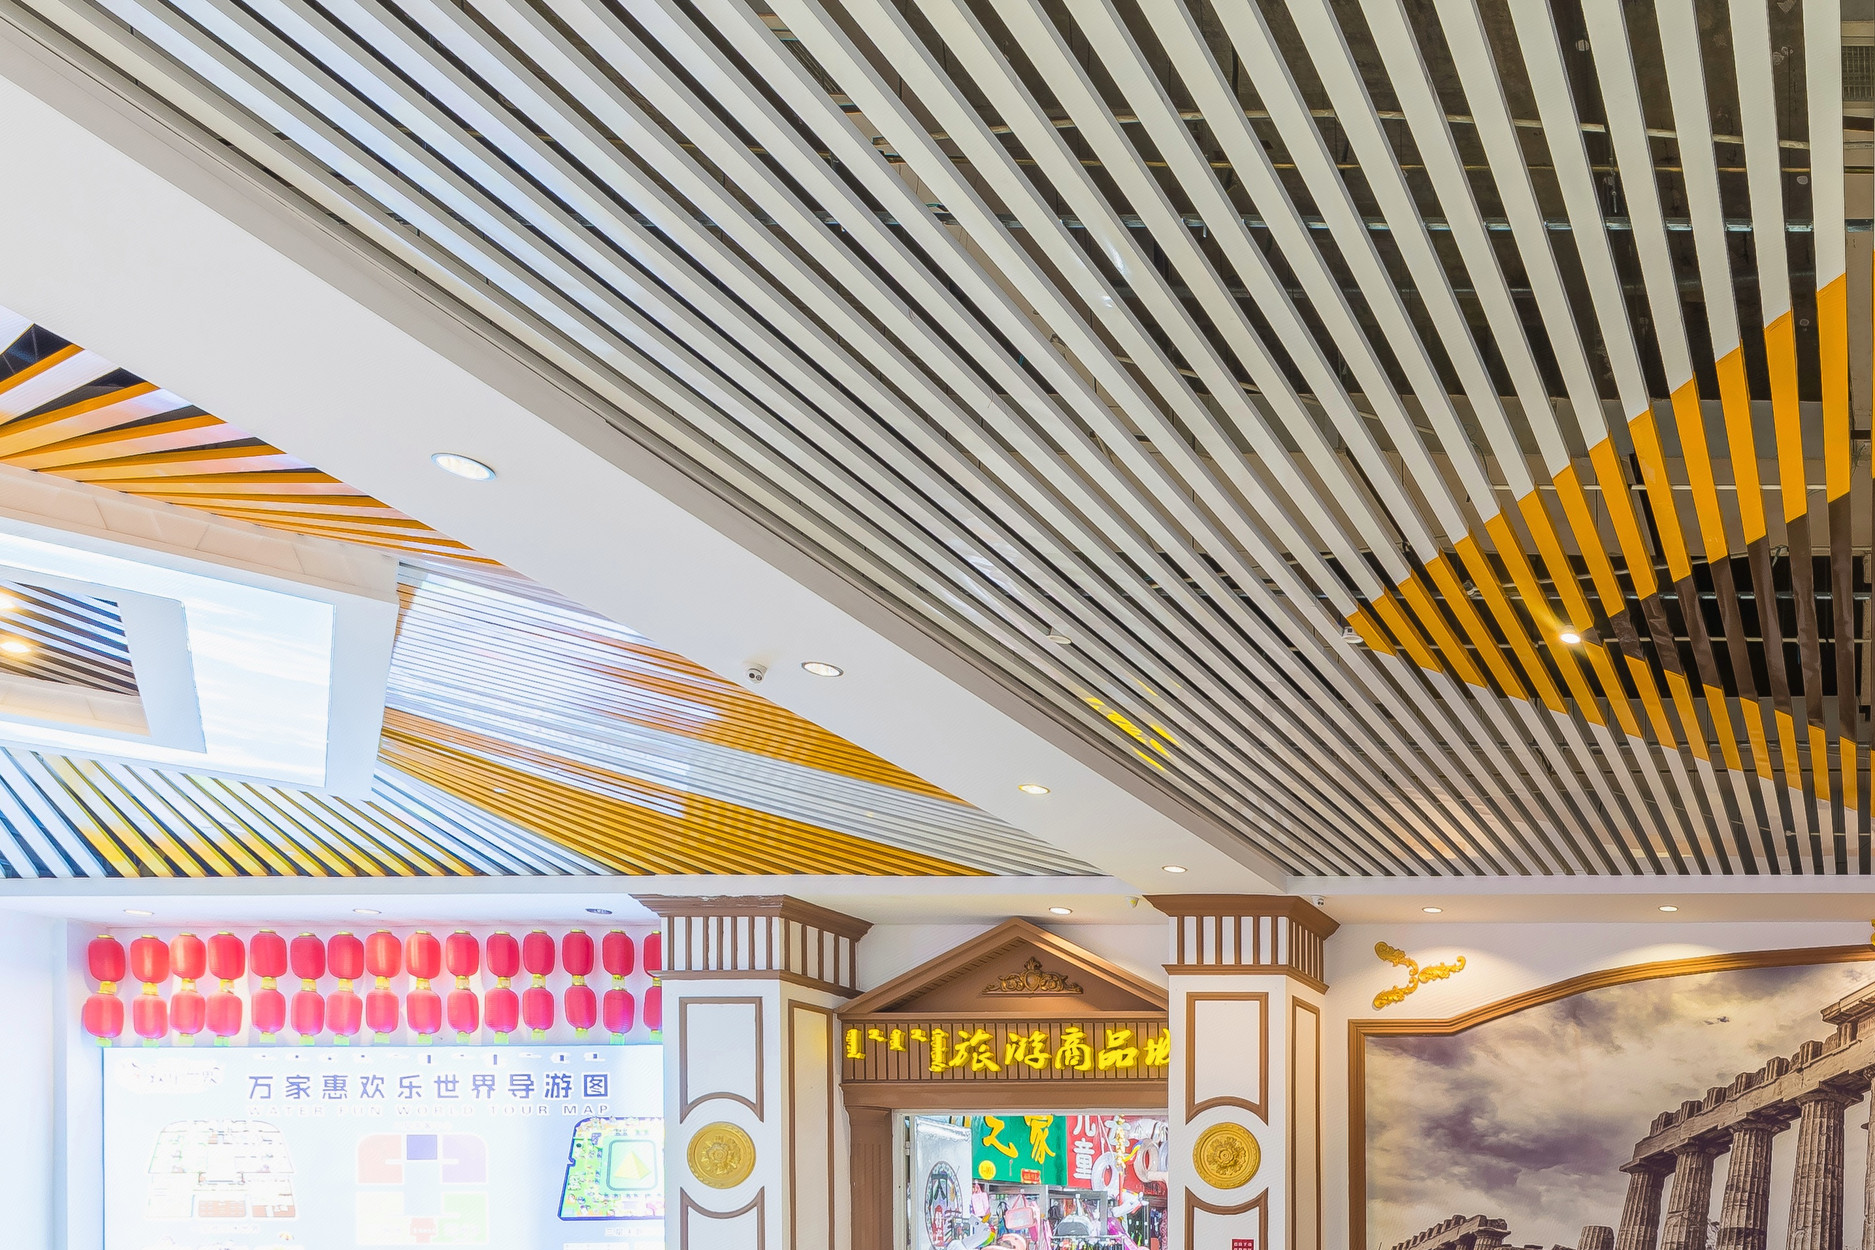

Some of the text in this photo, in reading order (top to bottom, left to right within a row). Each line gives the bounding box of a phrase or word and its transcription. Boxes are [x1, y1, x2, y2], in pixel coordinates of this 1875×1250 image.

[249, 1074, 609, 1099] 万家惠欢乐世界导游图
[564, 1106, 609, 1115] MAP
[1073, 1115, 1097, 1179] 儿童
